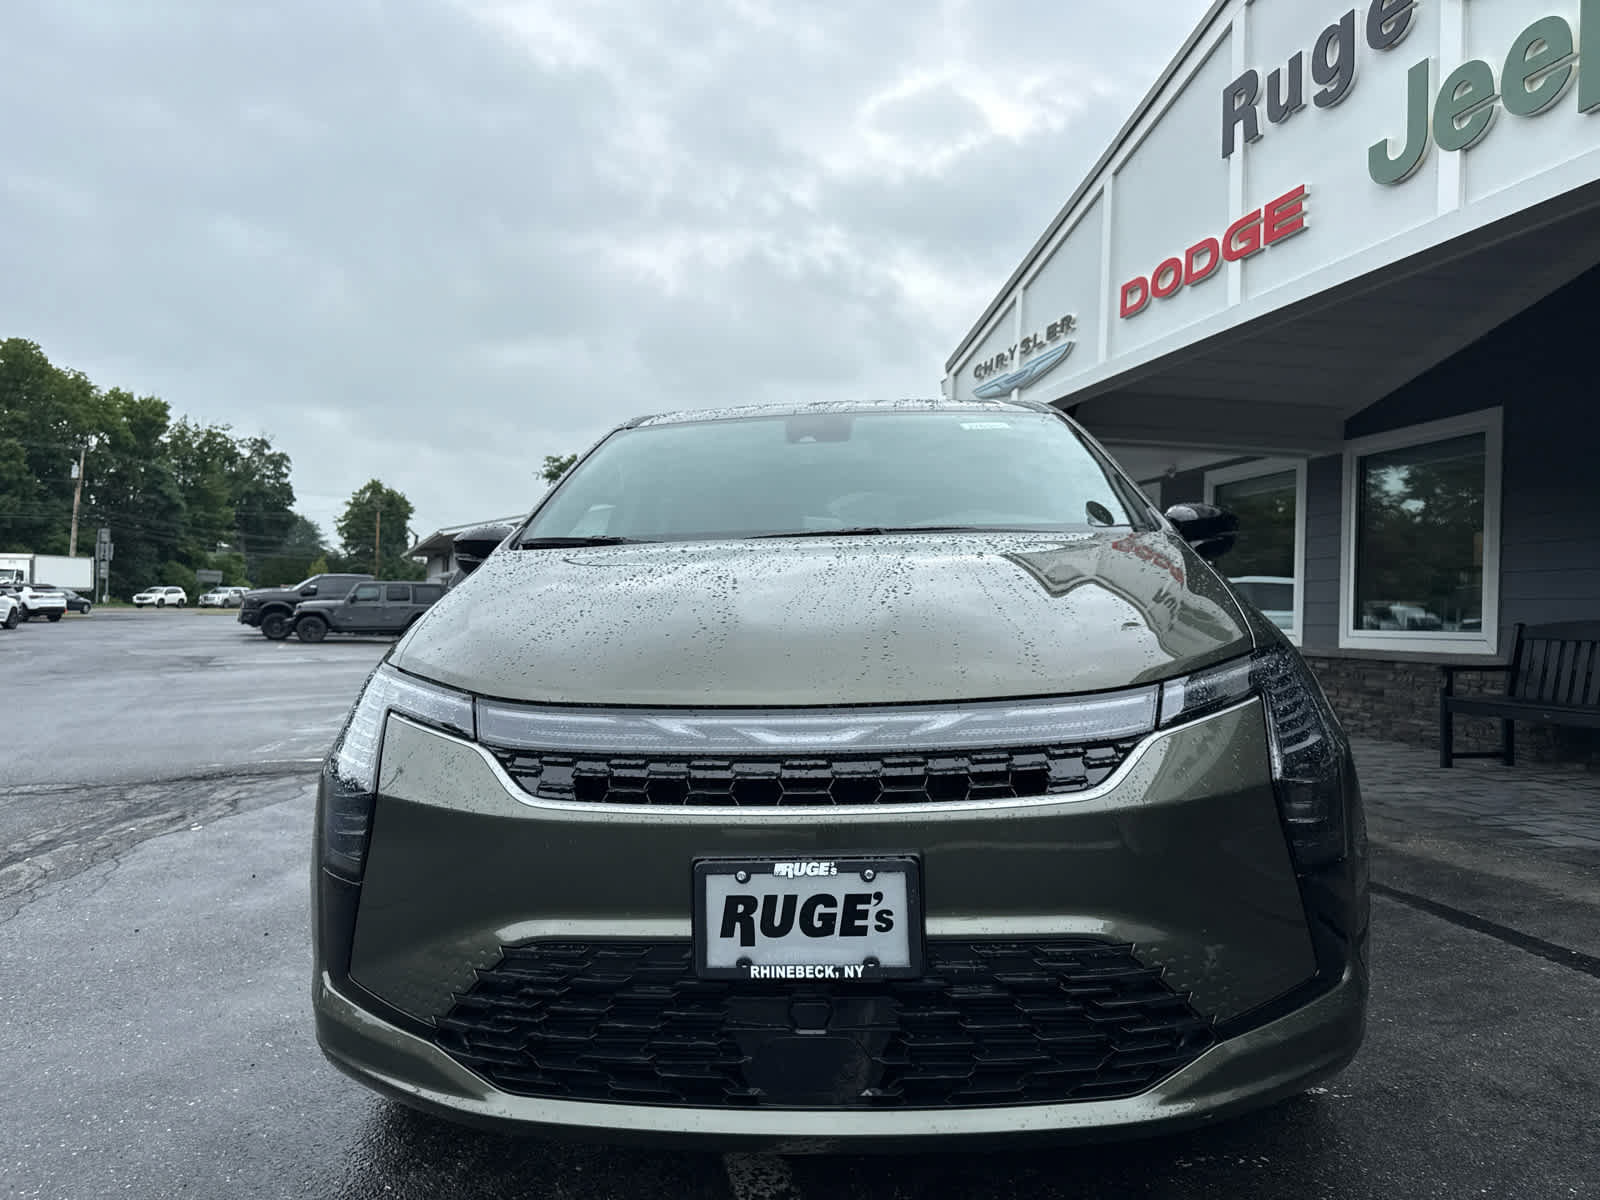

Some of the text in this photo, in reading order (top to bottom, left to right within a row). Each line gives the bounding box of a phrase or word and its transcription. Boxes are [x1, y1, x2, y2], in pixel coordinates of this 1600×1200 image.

[1221, 0, 1415, 159] Ruge
[1368, 0, 1600, 185] Jee
[1120, 184, 1306, 319] DODGE
[973, 314, 1076, 379] CHRYSLER
[774, 862, 837, 878] RUGE's
[720, 892, 894, 947] RUGE's
[750, 965, 864, 979] RHINEBECK, NY
